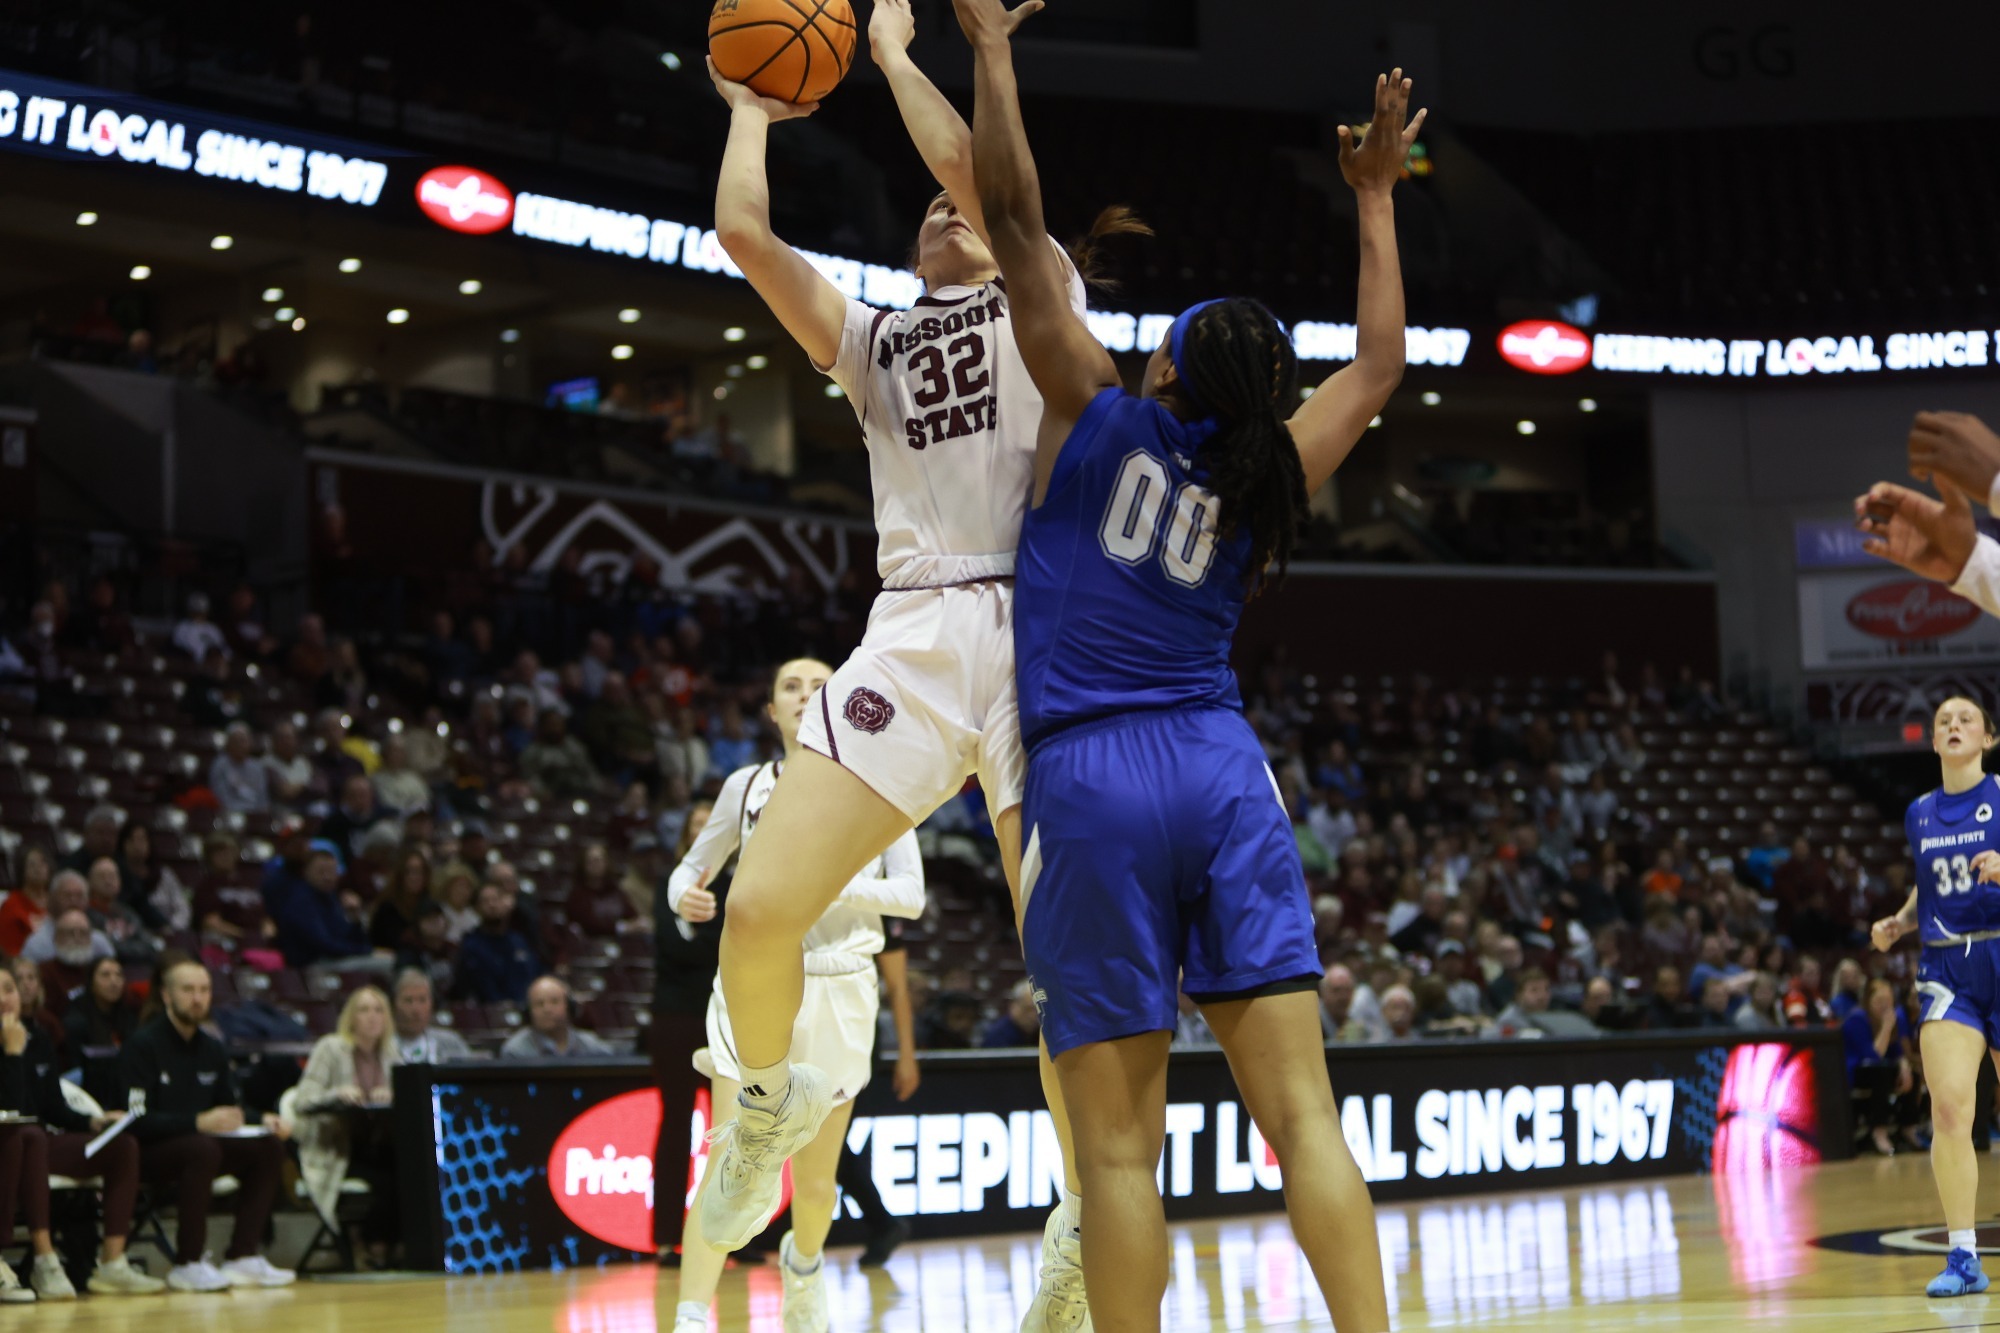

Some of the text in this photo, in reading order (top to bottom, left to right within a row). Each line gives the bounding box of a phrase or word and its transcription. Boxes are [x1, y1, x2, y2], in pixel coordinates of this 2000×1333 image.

[1692, 23, 1796, 81] GG
[22, 96, 66, 145] IT
[66, 108, 192, 172] LOCAL
[194, 129, 306, 193] SINCE
[307, 150, 389, 206] 1967
[512, 191, 650, 259] KEEPING
[648, 218, 686, 264] IT
[907, 331, 990, 409] 32
[1592, 333, 1727, 376] KEEPING
[1728, 339, 1764, 377] IT
[1765, 335, 1882, 377] LOCAL
[1885, 330, 1988, 369] SINCE
[1097, 447, 1222, 590] 00
[1932, 854, 1973, 896] 33
[1414, 1084, 1566, 1179] SINCE
[1572, 1078, 1675, 1166] 1967
